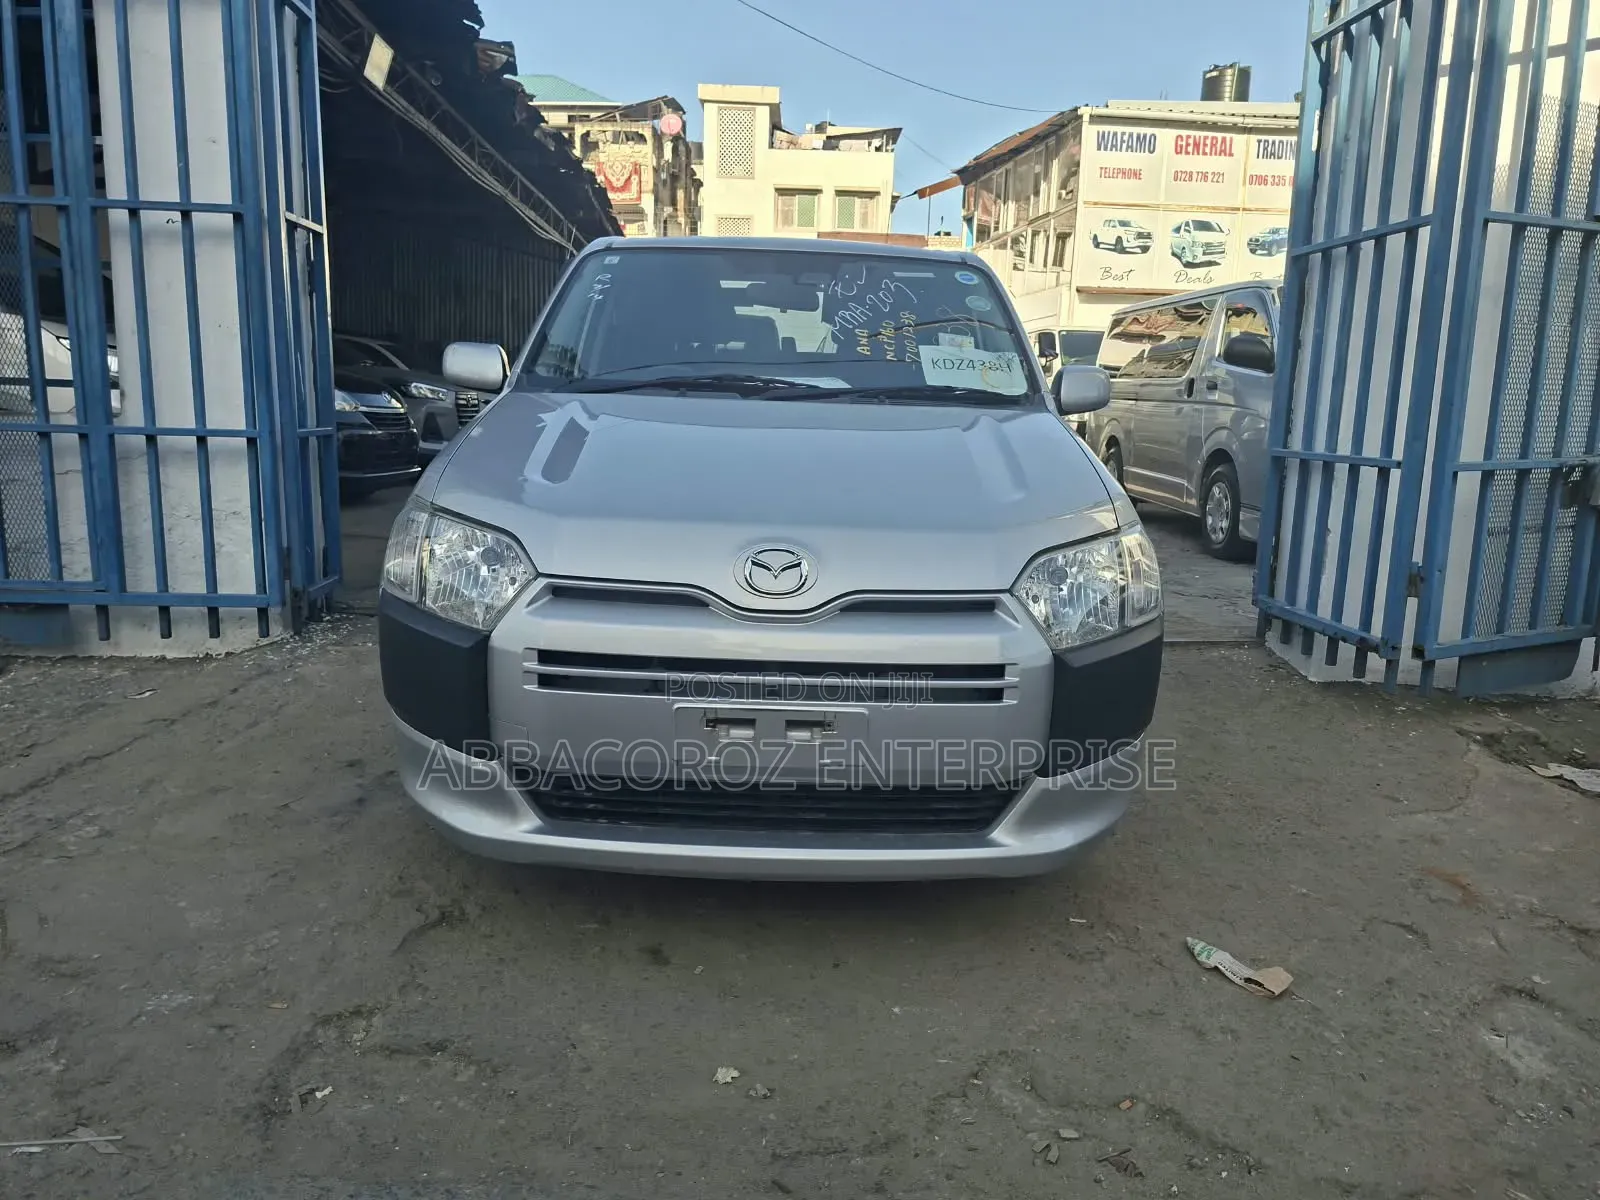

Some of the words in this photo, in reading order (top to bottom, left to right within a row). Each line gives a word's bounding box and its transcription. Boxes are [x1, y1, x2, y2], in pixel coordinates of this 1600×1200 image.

[1096, 130, 1157, 155] WAFAMO
[1174, 134, 1235, 158] GENERAL
[1099, 167, 1143, 181] TELEPHONE
[1173, 170, 1193, 183] 0728
[1195, 171, 1209, 183] 776
[1210, 172, 1225, 184] 221
[1248, 174, 1269, 187] 0706
[1270, 175, 1287, 187] 335
[1100, 267, 1136, 282] Best
[1173, 270, 1215, 285] Deals
